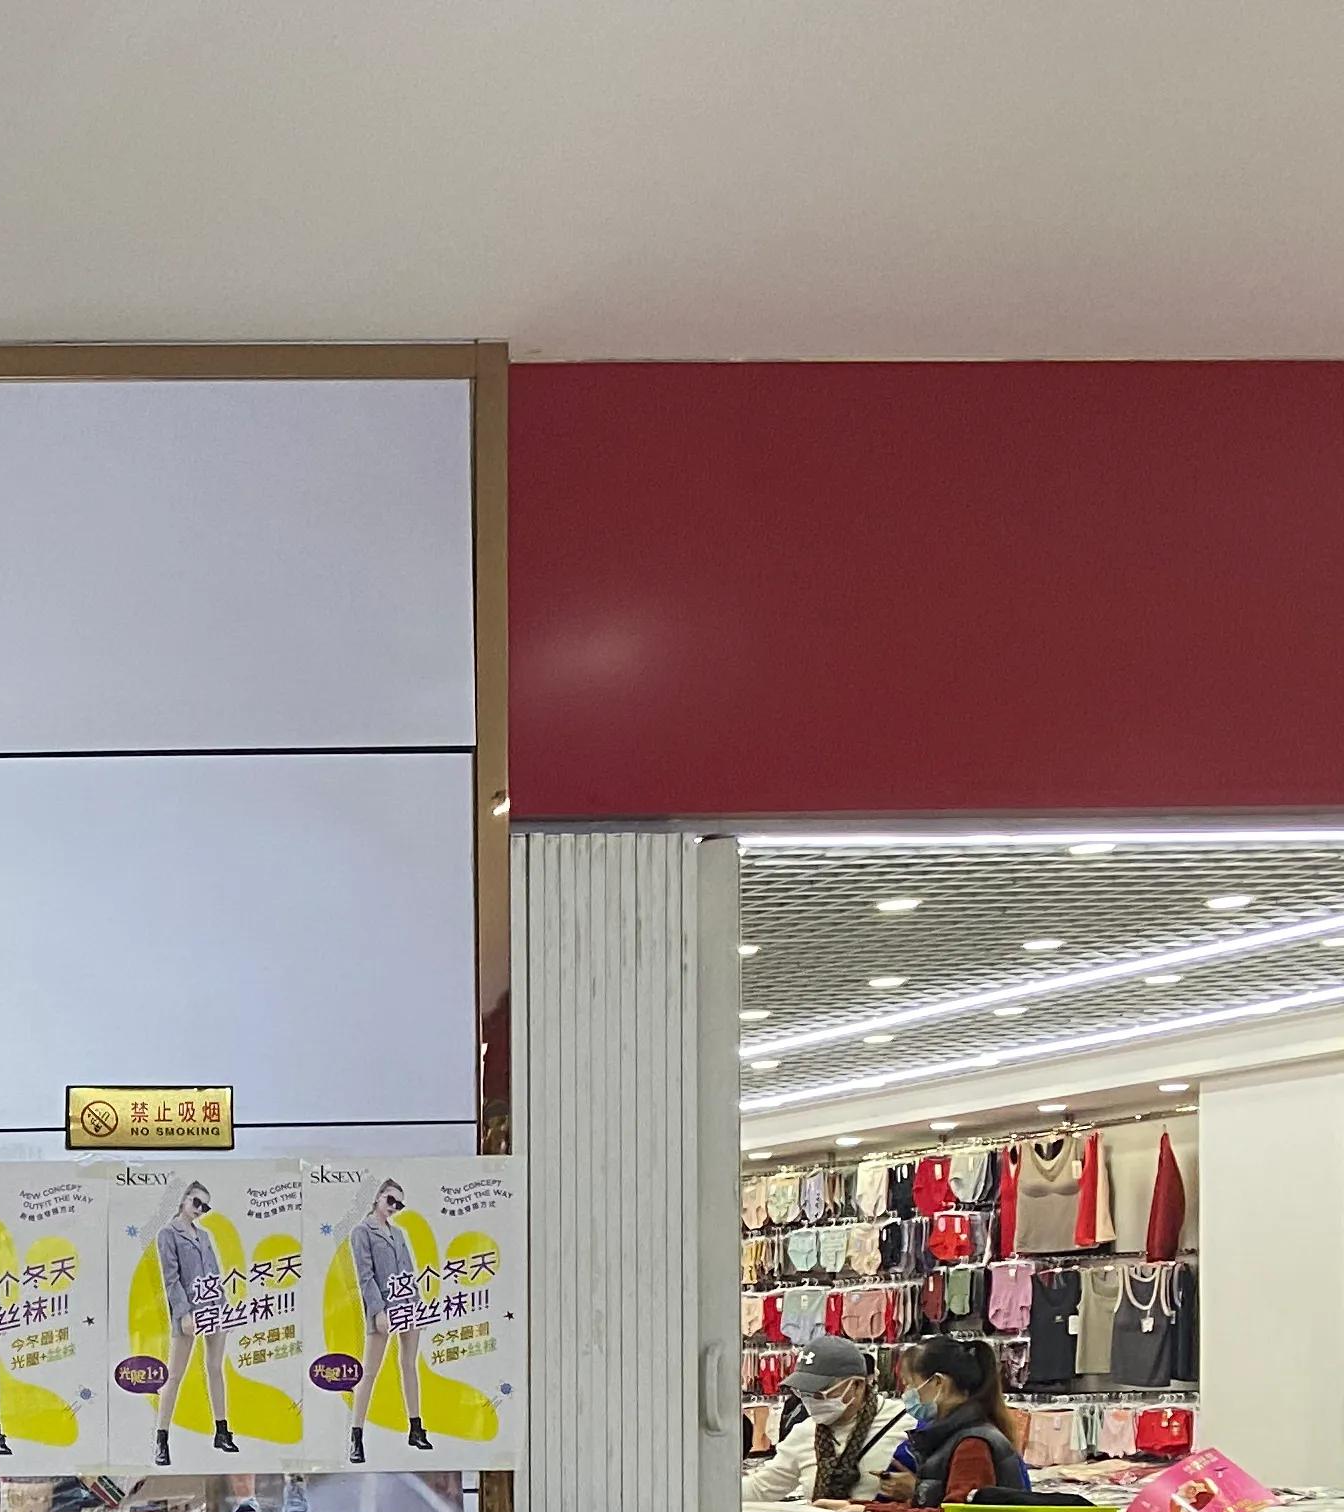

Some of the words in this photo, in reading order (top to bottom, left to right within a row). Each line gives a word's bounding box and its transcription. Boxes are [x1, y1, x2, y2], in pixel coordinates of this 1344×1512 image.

[130, 1101, 221, 1124] 禁止吸烟
[130, 1127, 150, 1136] NO
[156, 1127, 221, 1136] SMOKING
[194, 1254, 302, 1304] 这个冬天
[388, 1251, 497, 1300] 这个冬天
